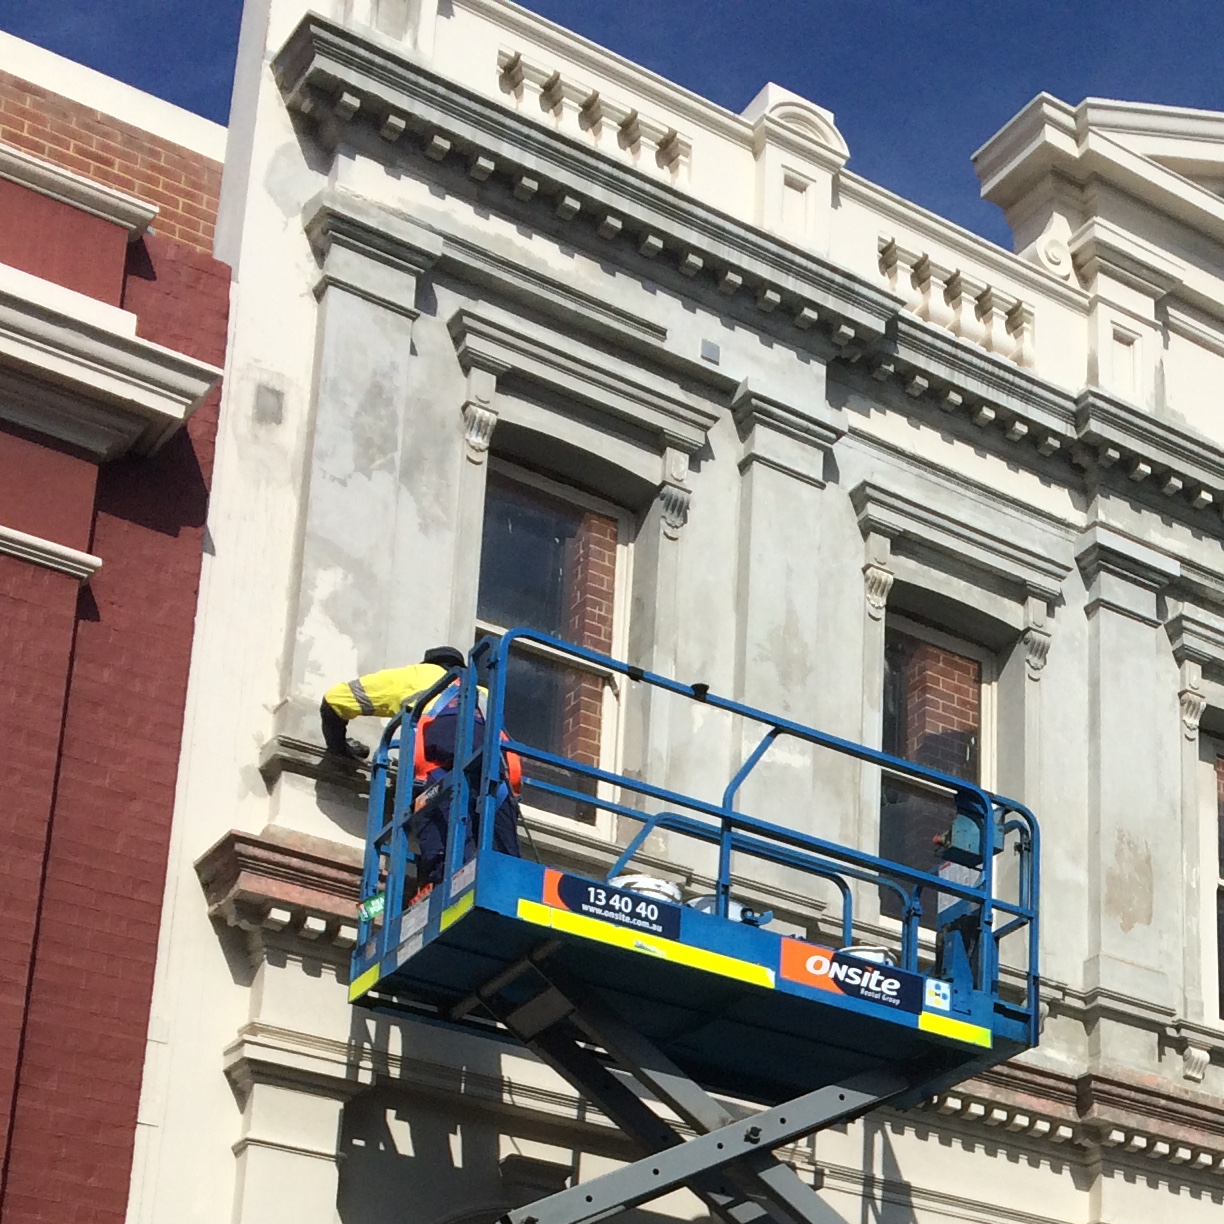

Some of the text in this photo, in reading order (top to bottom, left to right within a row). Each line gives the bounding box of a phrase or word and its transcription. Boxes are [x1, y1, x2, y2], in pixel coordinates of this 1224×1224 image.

[581, 903, 663, 933] www.onsite.com.au
[588, 887, 659, 921] 13 40 40
